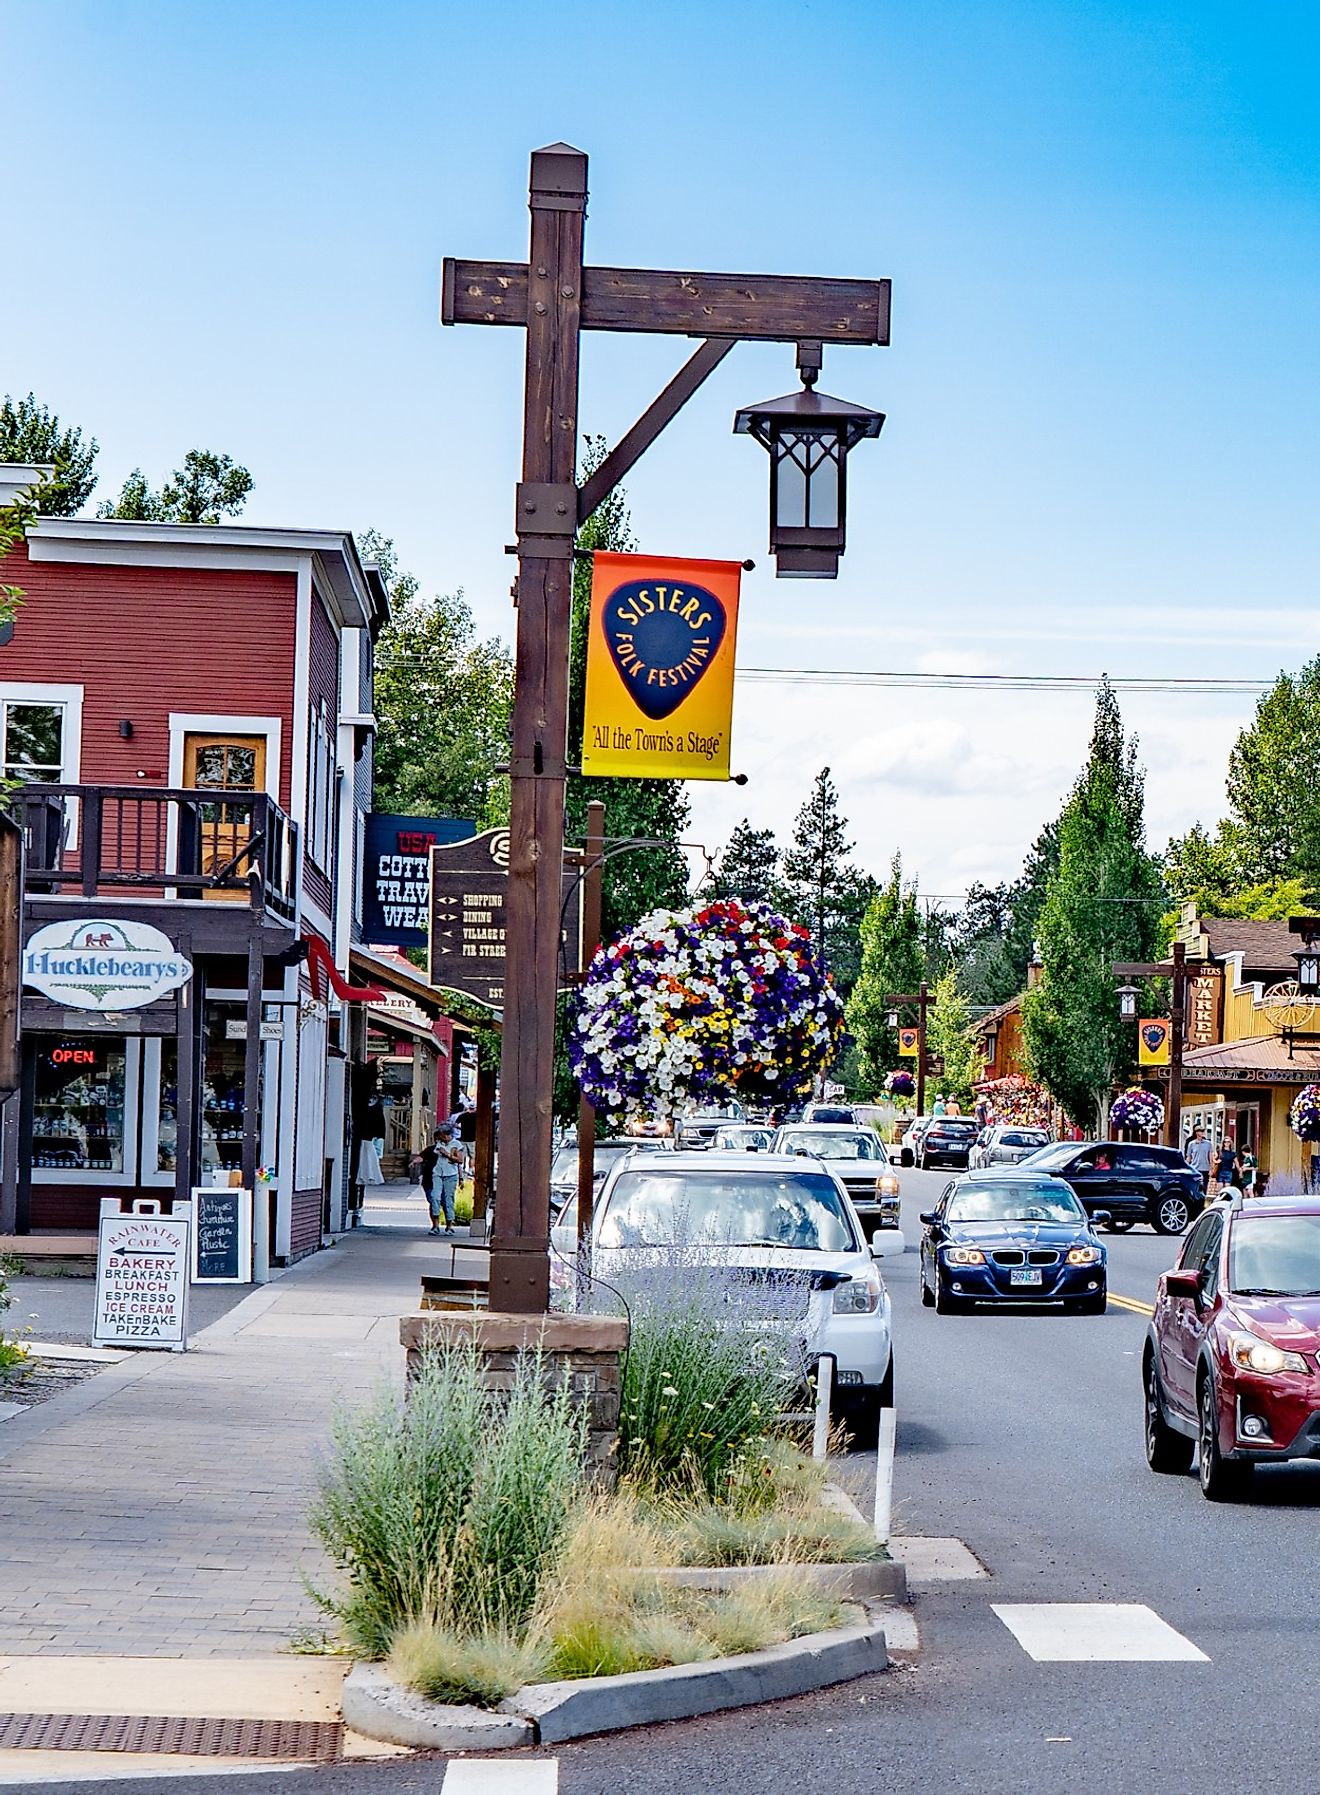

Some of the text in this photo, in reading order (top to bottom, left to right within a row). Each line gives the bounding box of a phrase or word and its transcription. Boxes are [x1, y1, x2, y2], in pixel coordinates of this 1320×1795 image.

[617, 587, 712, 630] SISTERS
[616, 633, 709, 687] FOLK FESTIVAL
[613, 727, 631, 749] the
[635, 728, 673, 752] Town's
[677, 736, 683, 752] a
[398, 832, 436, 853] USA
[463, 894, 502, 907] SHOPPING
[463, 911, 492, 923] DINING
[463, 928, 498, 940] VILLAGE
[463, 944, 477, 956] FIR
[27, 952, 178, 983] Hucklebearys
[1196, 977, 1214, 1044] MARKET
[52, 1049, 94, 1064] OPEN
[108, 1225, 181, 1248] RAINWATER
[128, 1238, 160, 1248] CAFE
[109, 1258, 176, 1270] BAKERY
[105, 1270, 179, 1281] BREAKFAST
[115, 1281, 168, 1292] LUNCH
[105, 1292, 176, 1303] ESPRESSO
[106, 1303, 174, 1314] ICE CREAM
[103, 1313, 177, 1326] TAKEnBAKE
[116, 1325, 161, 1336] PIZZA
